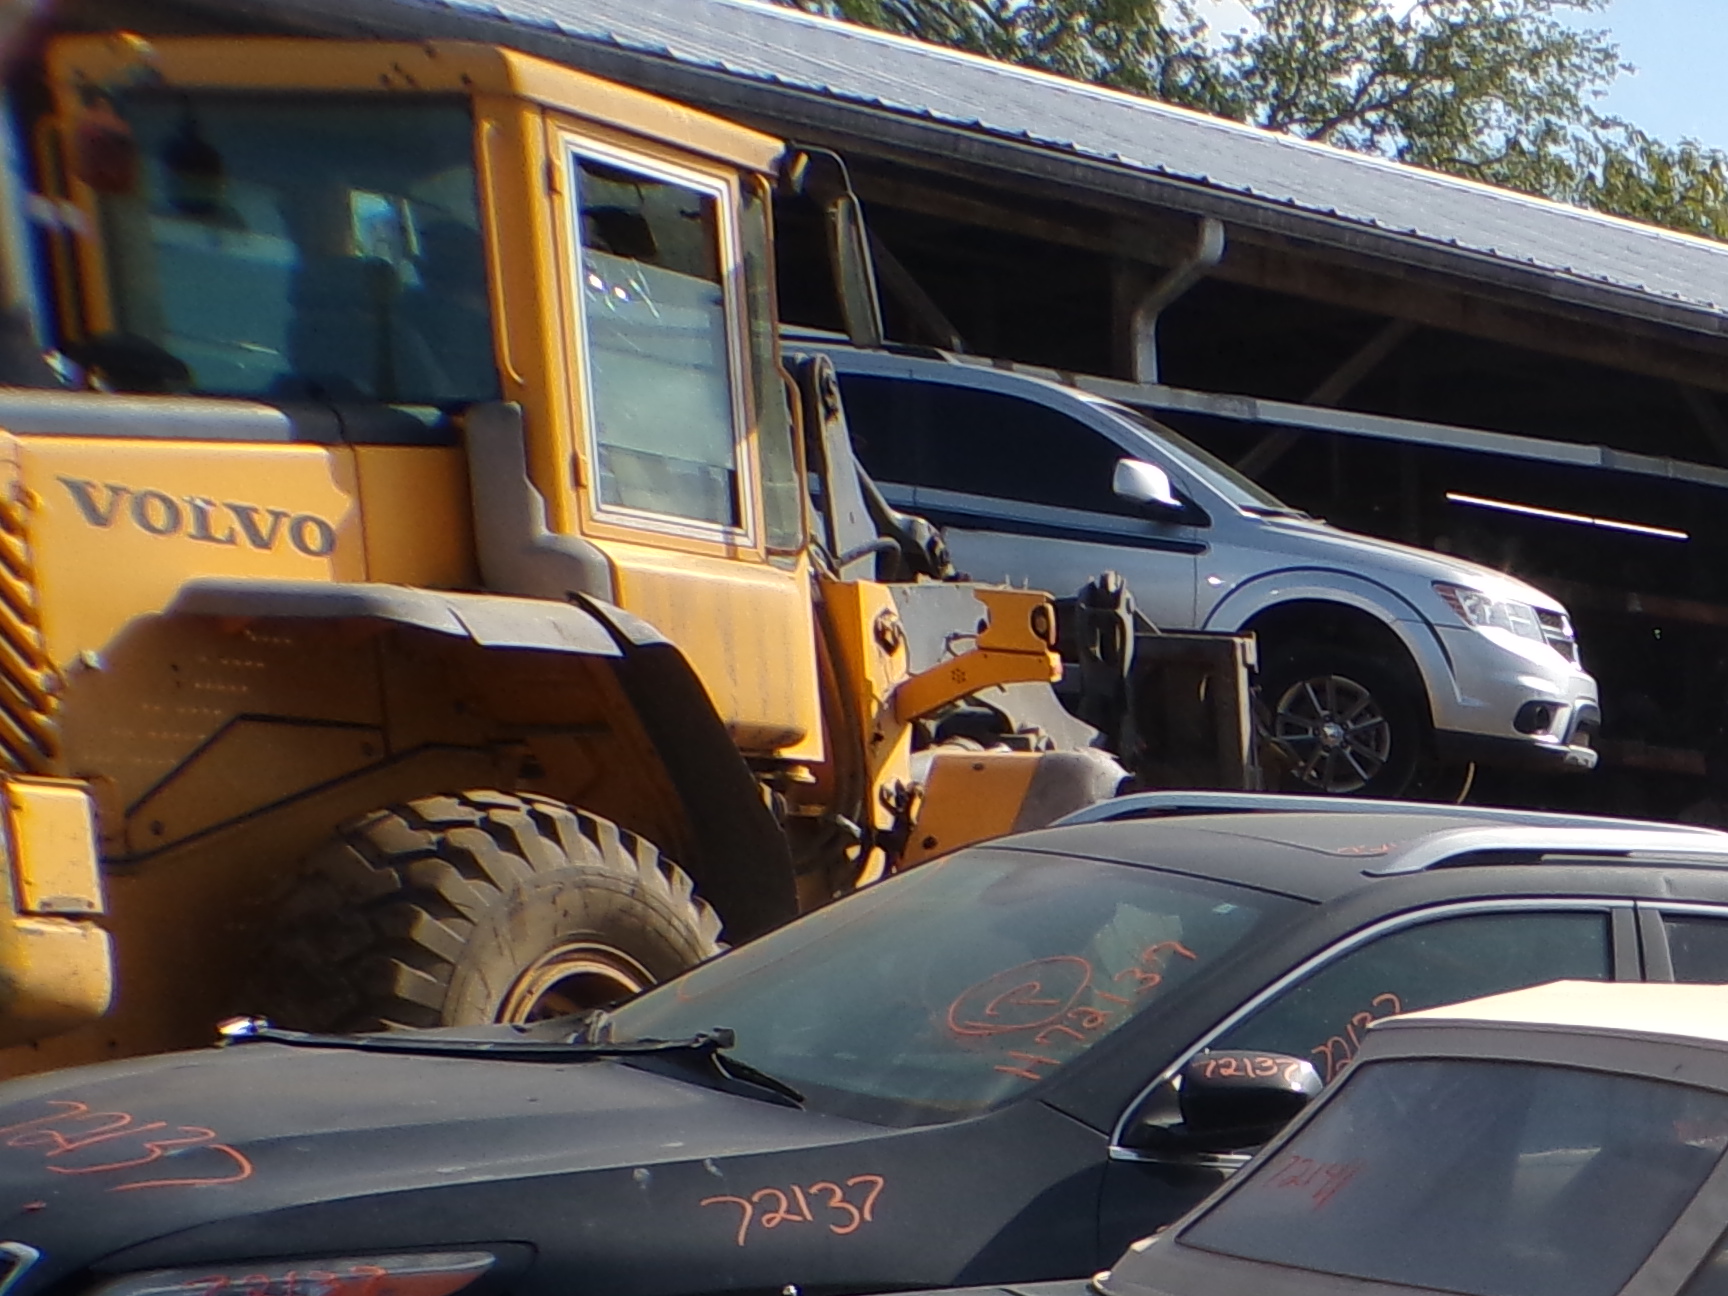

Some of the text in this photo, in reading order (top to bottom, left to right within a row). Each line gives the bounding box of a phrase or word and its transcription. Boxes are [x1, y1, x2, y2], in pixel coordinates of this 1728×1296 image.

[55, 475, 338, 558] VOLVO
[1192, 1056, 1300, 1081] 72137
[700, 1173, 885, 1247] 72137
